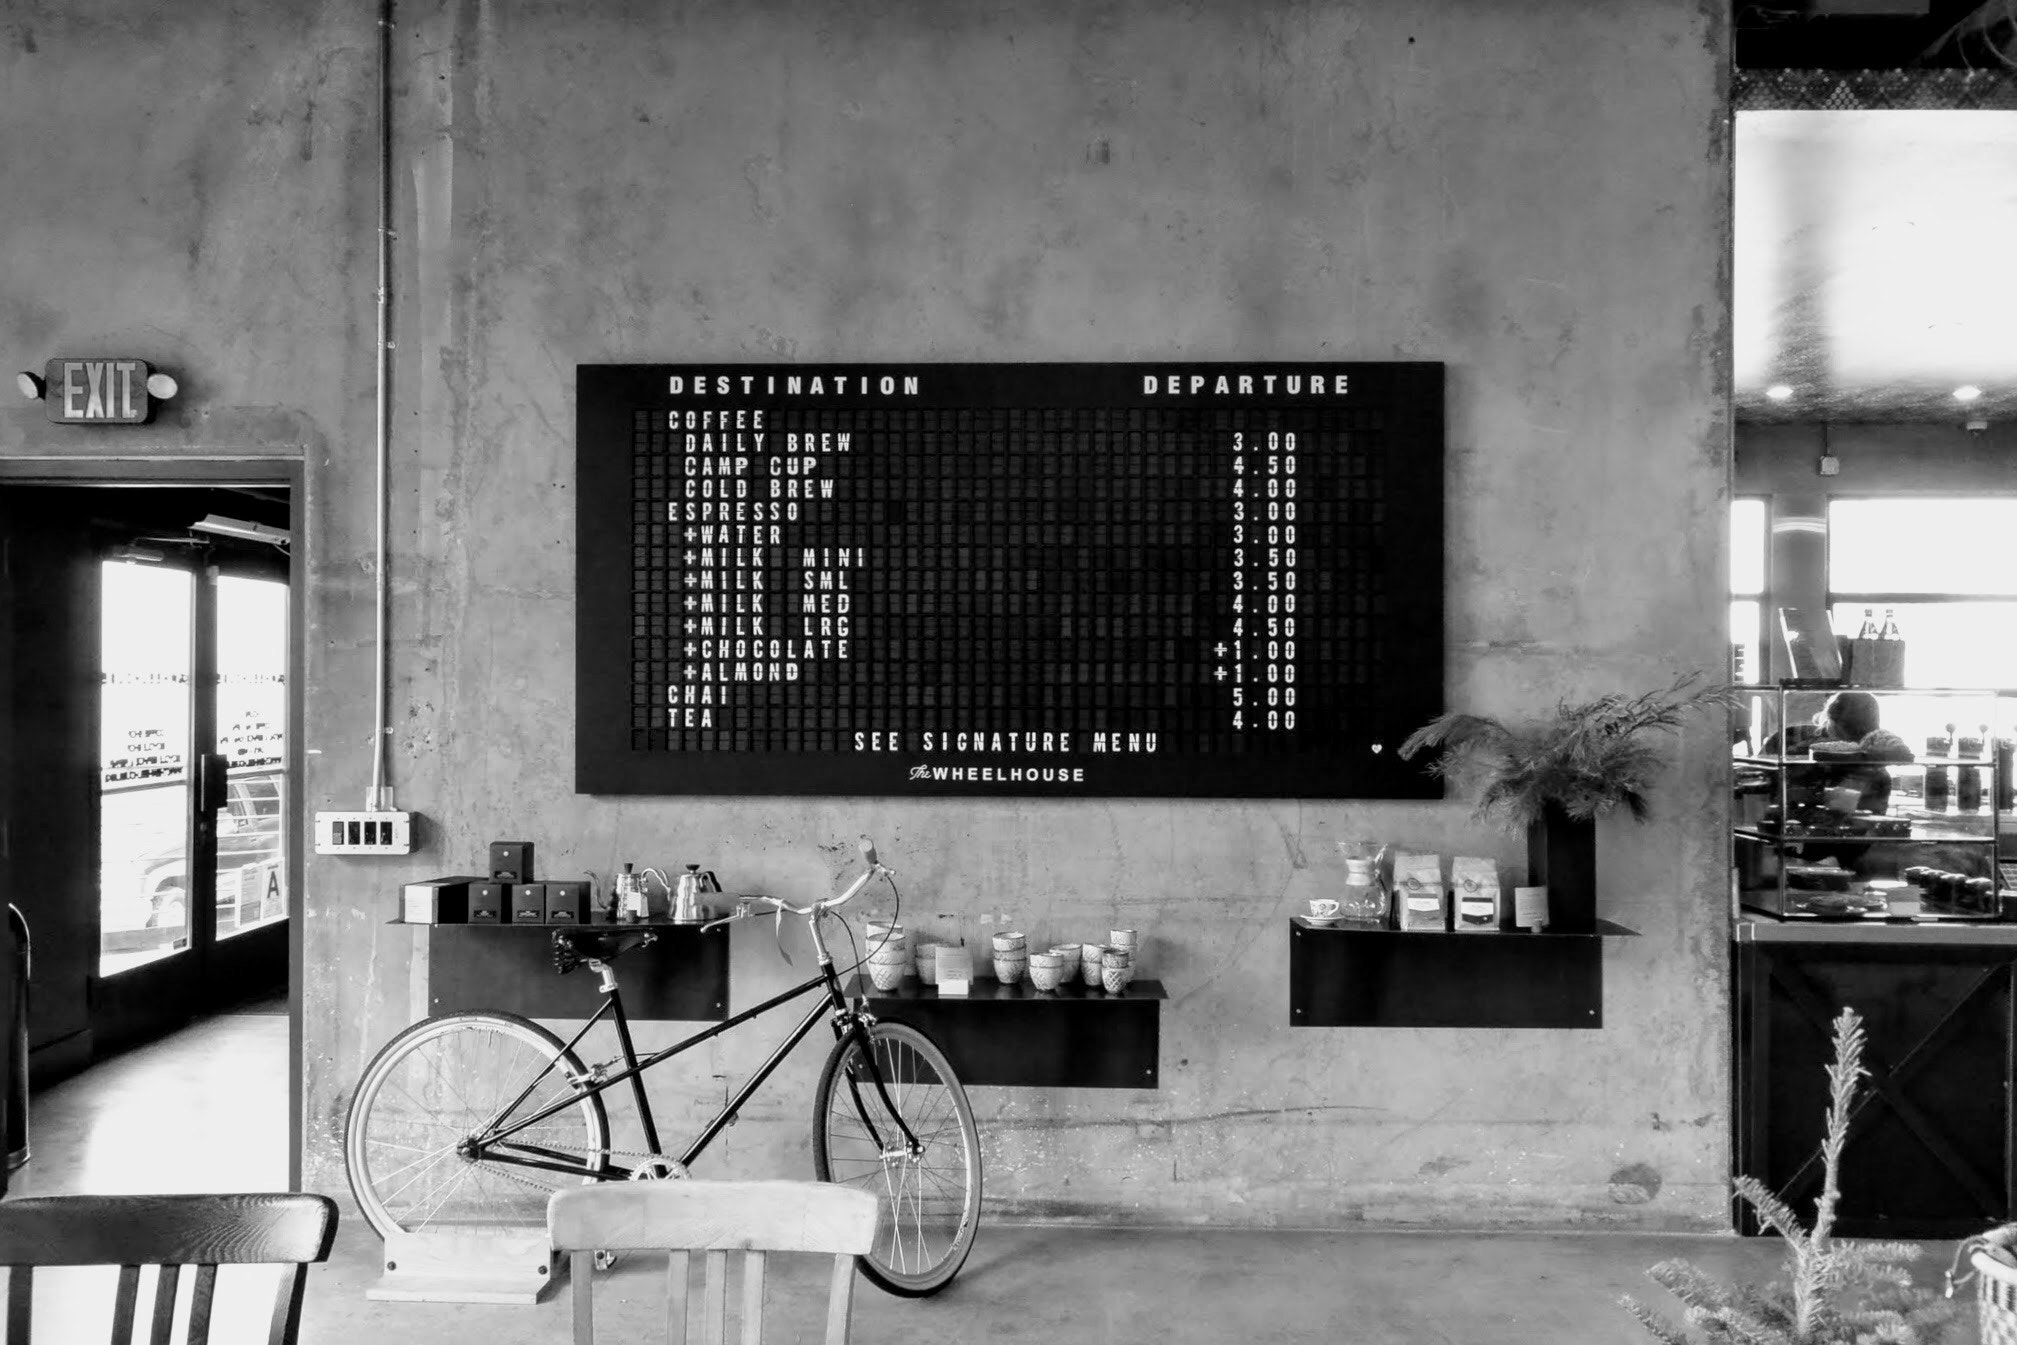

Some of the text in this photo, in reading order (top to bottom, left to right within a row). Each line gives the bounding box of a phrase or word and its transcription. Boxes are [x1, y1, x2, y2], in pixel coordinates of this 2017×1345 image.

[64, 362, 137, 419] EXIT
[669, 375, 918, 395] DESTINATION
[1143, 375, 1348, 395] DEPARTURE
[668, 409, 763, 430] COFFEE
[685, 432, 851, 453] DAILY BREW
[1232, 431, 1296, 452] 3.00
[684, 456, 817, 477] CAMP CUP
[1233, 455, 1296, 475] 4.50
[685, 478, 834, 499] COLD BREW
[1232, 478, 1296, 499] 4.00
[668, 501, 798, 522] ESPRESSO
[1233, 501, 1296, 521] 3.00
[684, 524, 781, 545] +WATER
[1233, 524, 1296, 545] 3.00
[683, 547, 863, 568] +MILK MINI
[1233, 547, 1296, 568] 3.50
[684, 570, 848, 590] +MILK SML
[1233, 570, 1296, 591] 3.50
[683, 593, 850, 614] +MILK MED
[1232, 593, 1296, 614] 4.00
[683, 616, 849, 637] +MILK LRG
[1232, 617, 1295, 638] 4.50
[683, 639, 848, 659] +CHOCOLATE
[1214, 639, 1295, 660] +1.00
[683, 662, 799, 682] +ALMOND
[1214, 663, 1295, 684] +1.00
[667, 684, 727, 705] CHAI
[1232, 687, 1296, 707] 5.00
[667, 707, 712, 728] TEA
[1232, 710, 1295, 730] 4.00
[854, 731, 1157, 753] SEE SIGNATURE MENU
[909, 764, 1085, 783] The WHEELHOUSE
